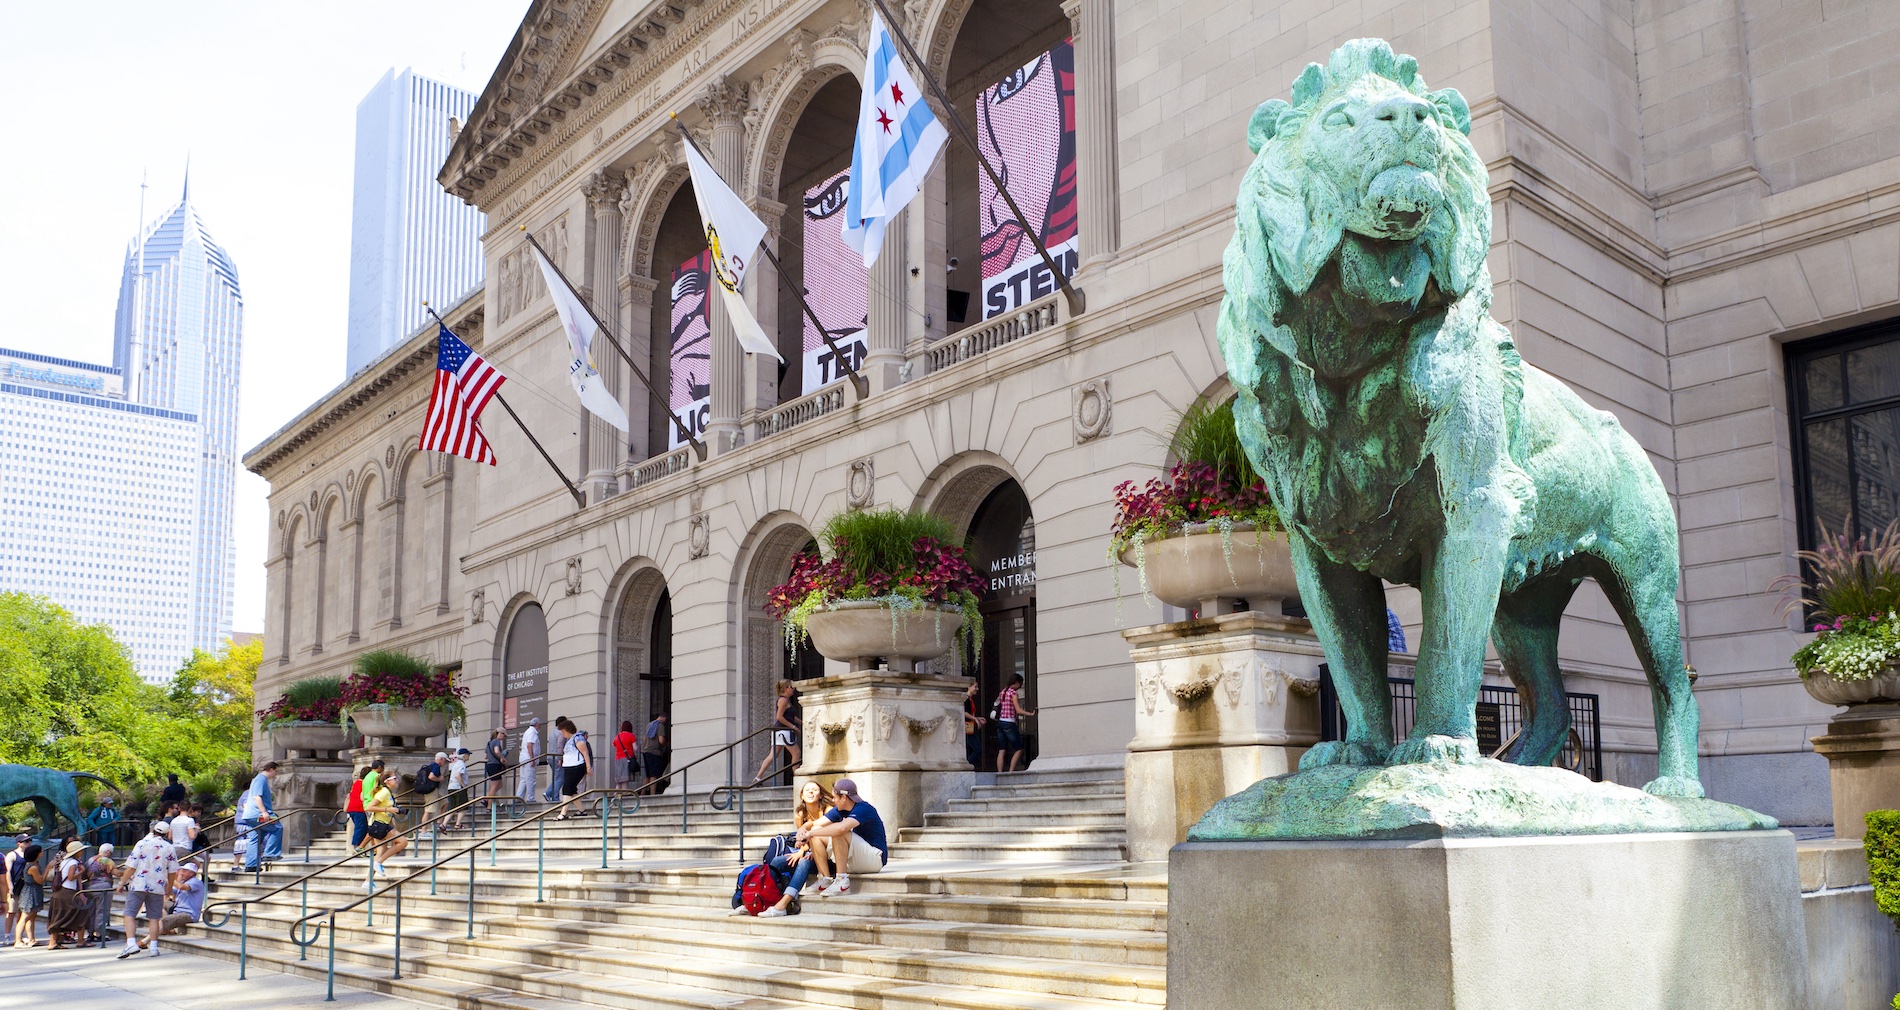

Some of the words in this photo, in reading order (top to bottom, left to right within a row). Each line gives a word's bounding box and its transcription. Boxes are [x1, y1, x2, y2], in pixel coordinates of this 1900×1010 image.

[635, 80, 661, 114] THE
[682, 41, 711, 79] ART
[731, 0, 783, 40] INSTI
[500, 189, 526, 218] ANNO
[532, 151, 573, 195] DOMINI
[987, 249, 1079, 319] STEIN
[8, 361, 104, 391] Prudential
[416, 381, 433, 399] VINC
[507, 683, 513, 691] OF
[514, 679, 533, 689] CHICAGO
[508, 672, 516, 680] THE
[517, 671, 525, 679] ART
[526, 666, 548, 677] INSTITUTE
